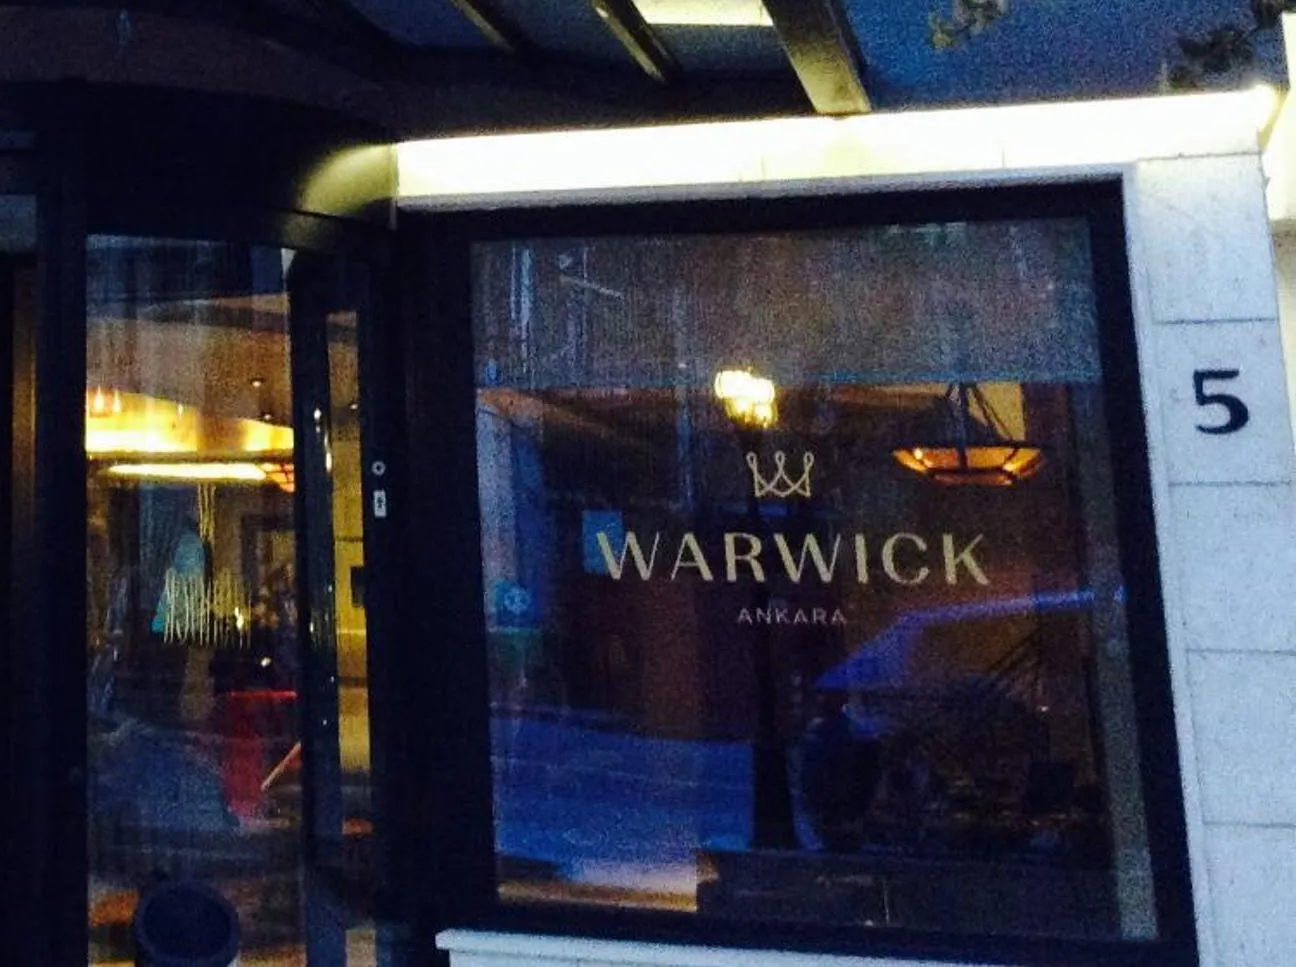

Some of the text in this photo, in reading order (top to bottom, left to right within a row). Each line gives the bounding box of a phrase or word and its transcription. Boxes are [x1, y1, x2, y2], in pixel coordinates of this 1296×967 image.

[1193, 369, 1249, 435] 5
[595, 531, 991, 586] WARWICK
[737, 606, 847, 625] ANKARA
